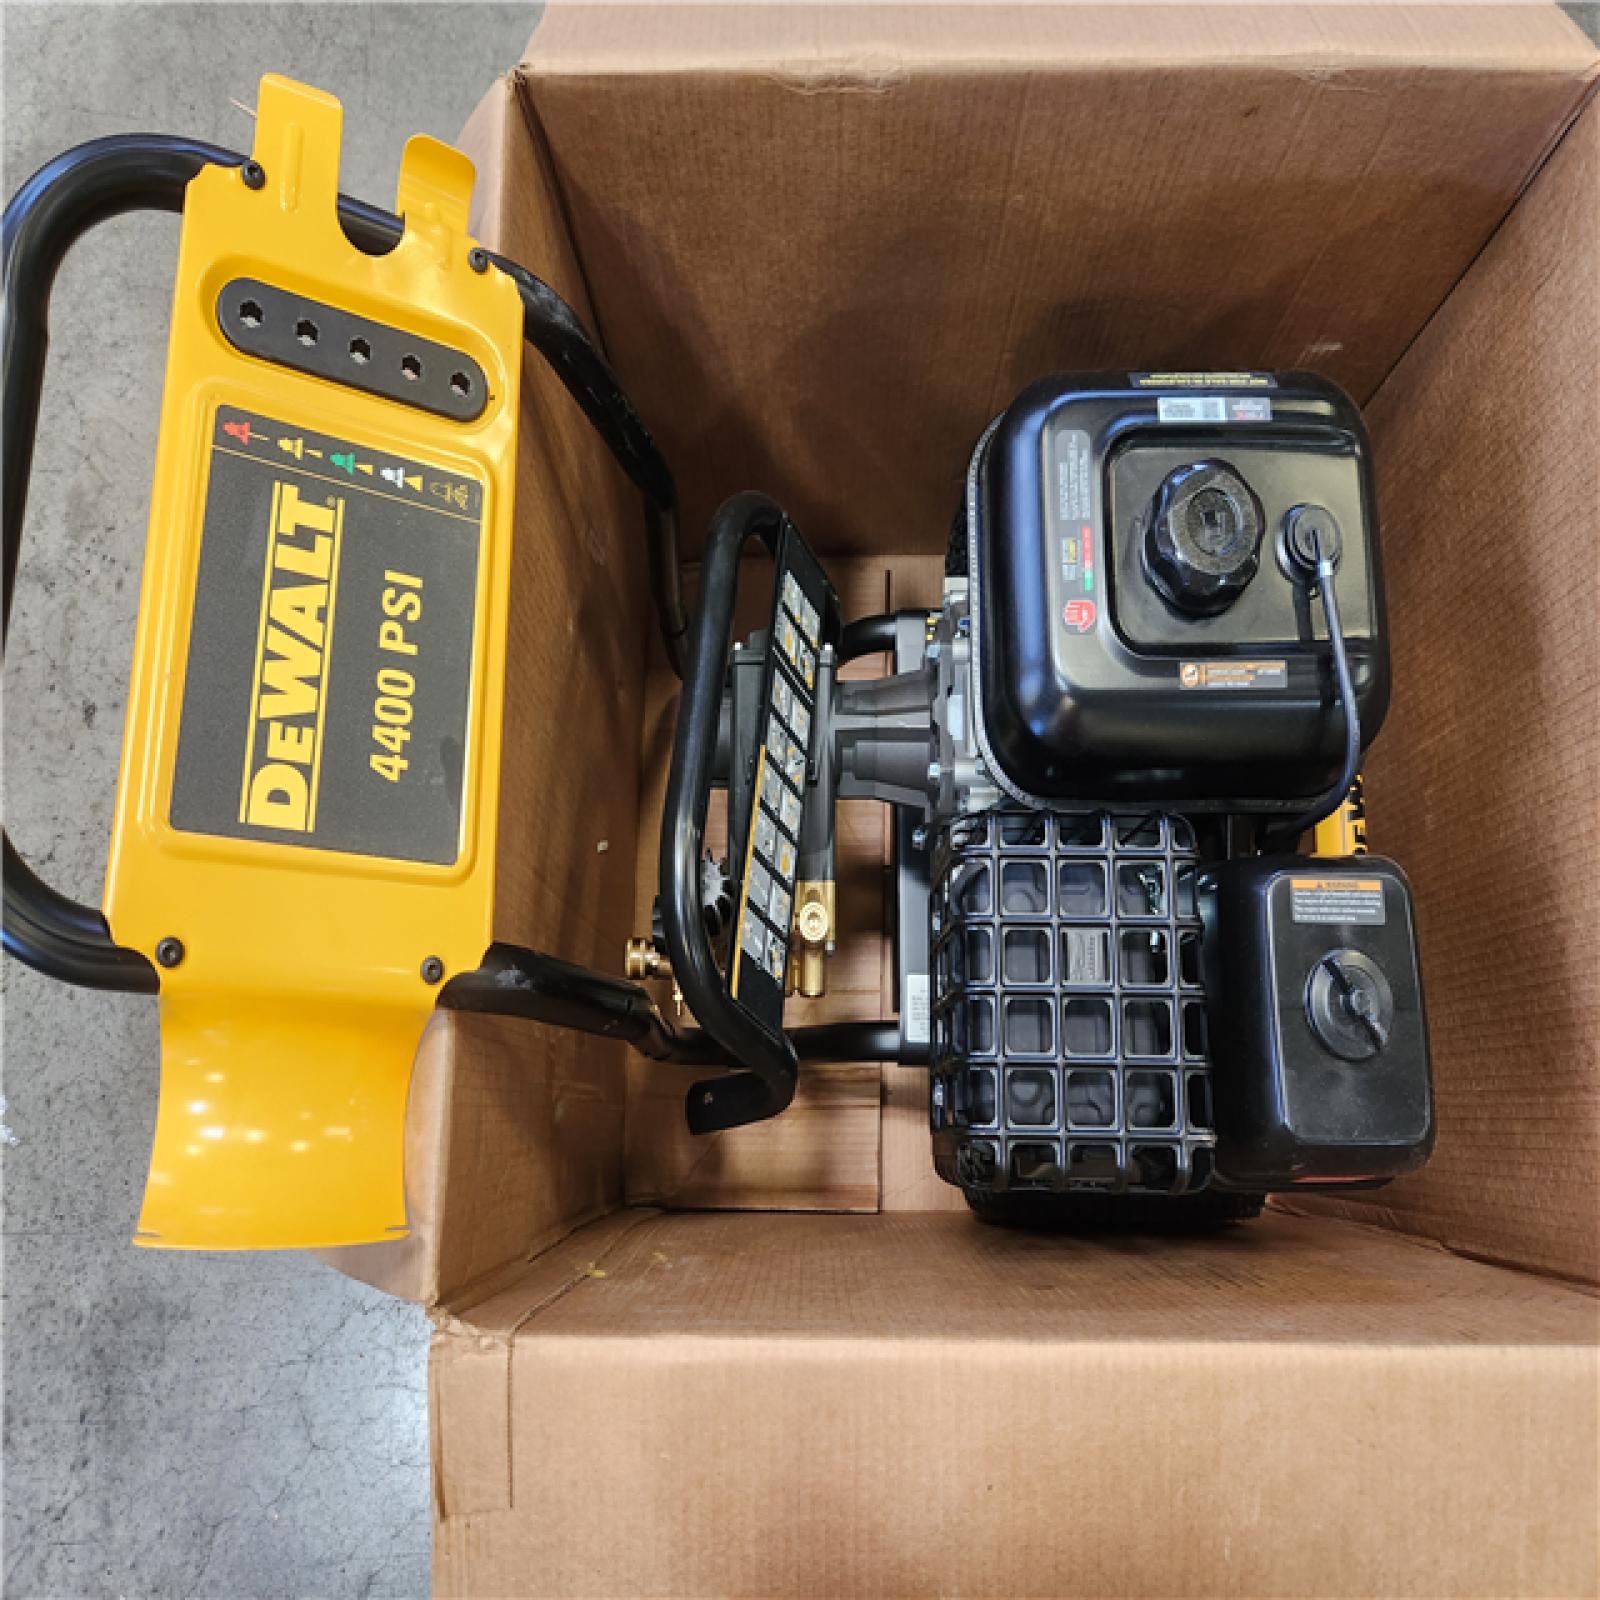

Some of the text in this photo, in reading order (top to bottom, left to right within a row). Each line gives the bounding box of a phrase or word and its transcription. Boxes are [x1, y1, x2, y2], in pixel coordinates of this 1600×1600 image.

[247, 484, 335, 831] DEWALT
[370, 569, 424, 782] 4400 PSI
